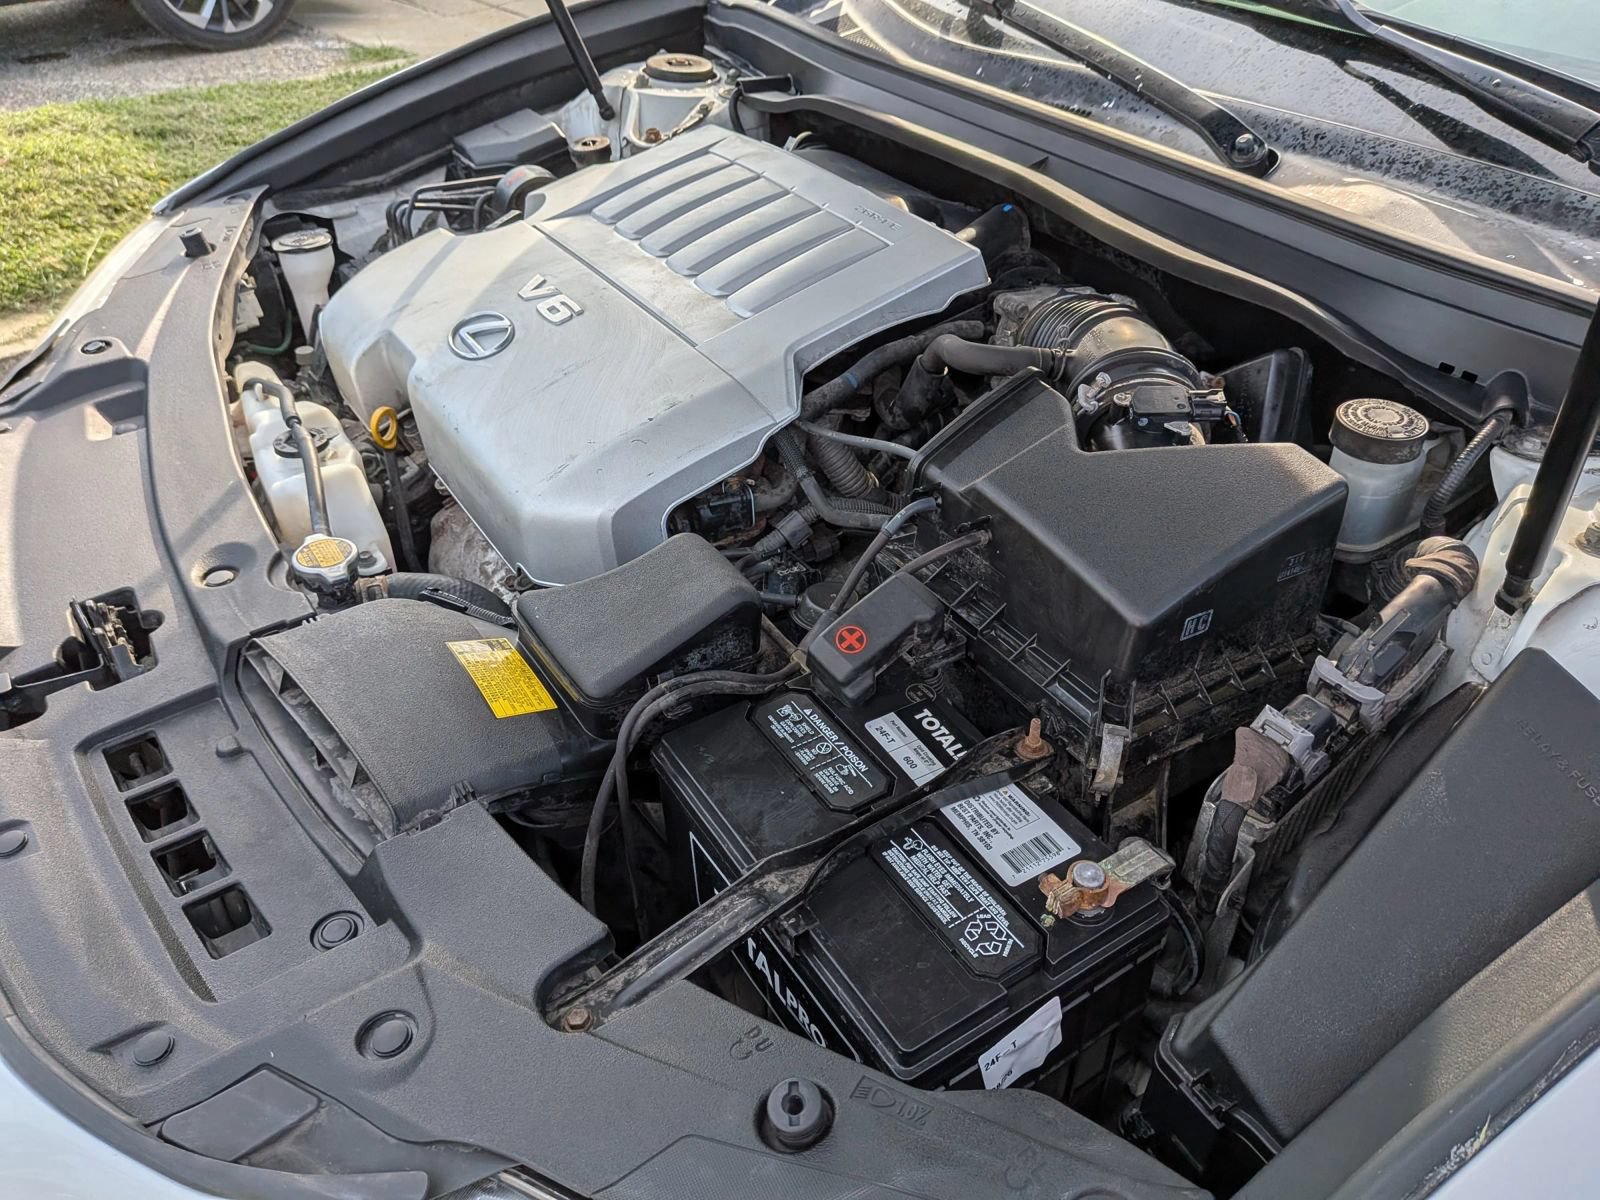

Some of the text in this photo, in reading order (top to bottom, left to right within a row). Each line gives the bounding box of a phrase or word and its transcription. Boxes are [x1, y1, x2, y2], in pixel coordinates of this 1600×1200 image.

[517, 273, 585, 326] V6
[778, 721, 792, 733] GASES
[795, 724, 806, 733] EYES
[808, 713, 839, 741] DANGER
[839, 745, 869, 772] POISON
[874, 724, 896, 745] 24F-T
[901, 754, 918, 770] 600
[825, 766, 855, 794] SULFURIC ACID
[828, 775, 839, 785] CAUSE
[956, 802, 970, 815] BEST
[962, 799, 993, 829] DISTRIBUTED
[1007, 794, 1031, 816] WARNING:
[948, 806, 974, 830] MEMPHIS,
[976, 835, 993, 850] 38103
[886, 849, 909, 873] INSTRUCTIONS
[910, 876, 925, 891] VEHICLE
[890, 862, 908, 880] AVAILABLE
[913, 887, 928, 901] SERVICE
[910, 854, 951, 897] MEDICAL HELP FAST
[915, 852, 928, 864] WITH
[941, 879, 952, 889] GET
[921, 848, 974, 903] FLUSH EYES IMMEDIATELY
[942, 849, 952, 859] KEEP
[950, 858, 959, 866] OUT
[969, 878, 983, 891] REACH
[918, 877, 929, 887] JUMP
[927, 886, 944, 904] STARTING
[941, 902, 957, 918] FOLLOW
[950, 865, 961, 875] KEEP
[959, 874, 970, 884] VENT
[968, 884, 979, 894] CAPS
[977, 894, 990, 906] TIGHT
[988, 905, 998, 914] AND
[976, 912, 992, 920] LEAD
[958, 937, 979, 959] RECYCLE
[747, 936, 827, 1049] TALPRO
[896, 1099, 933, 1126] 1.0%
